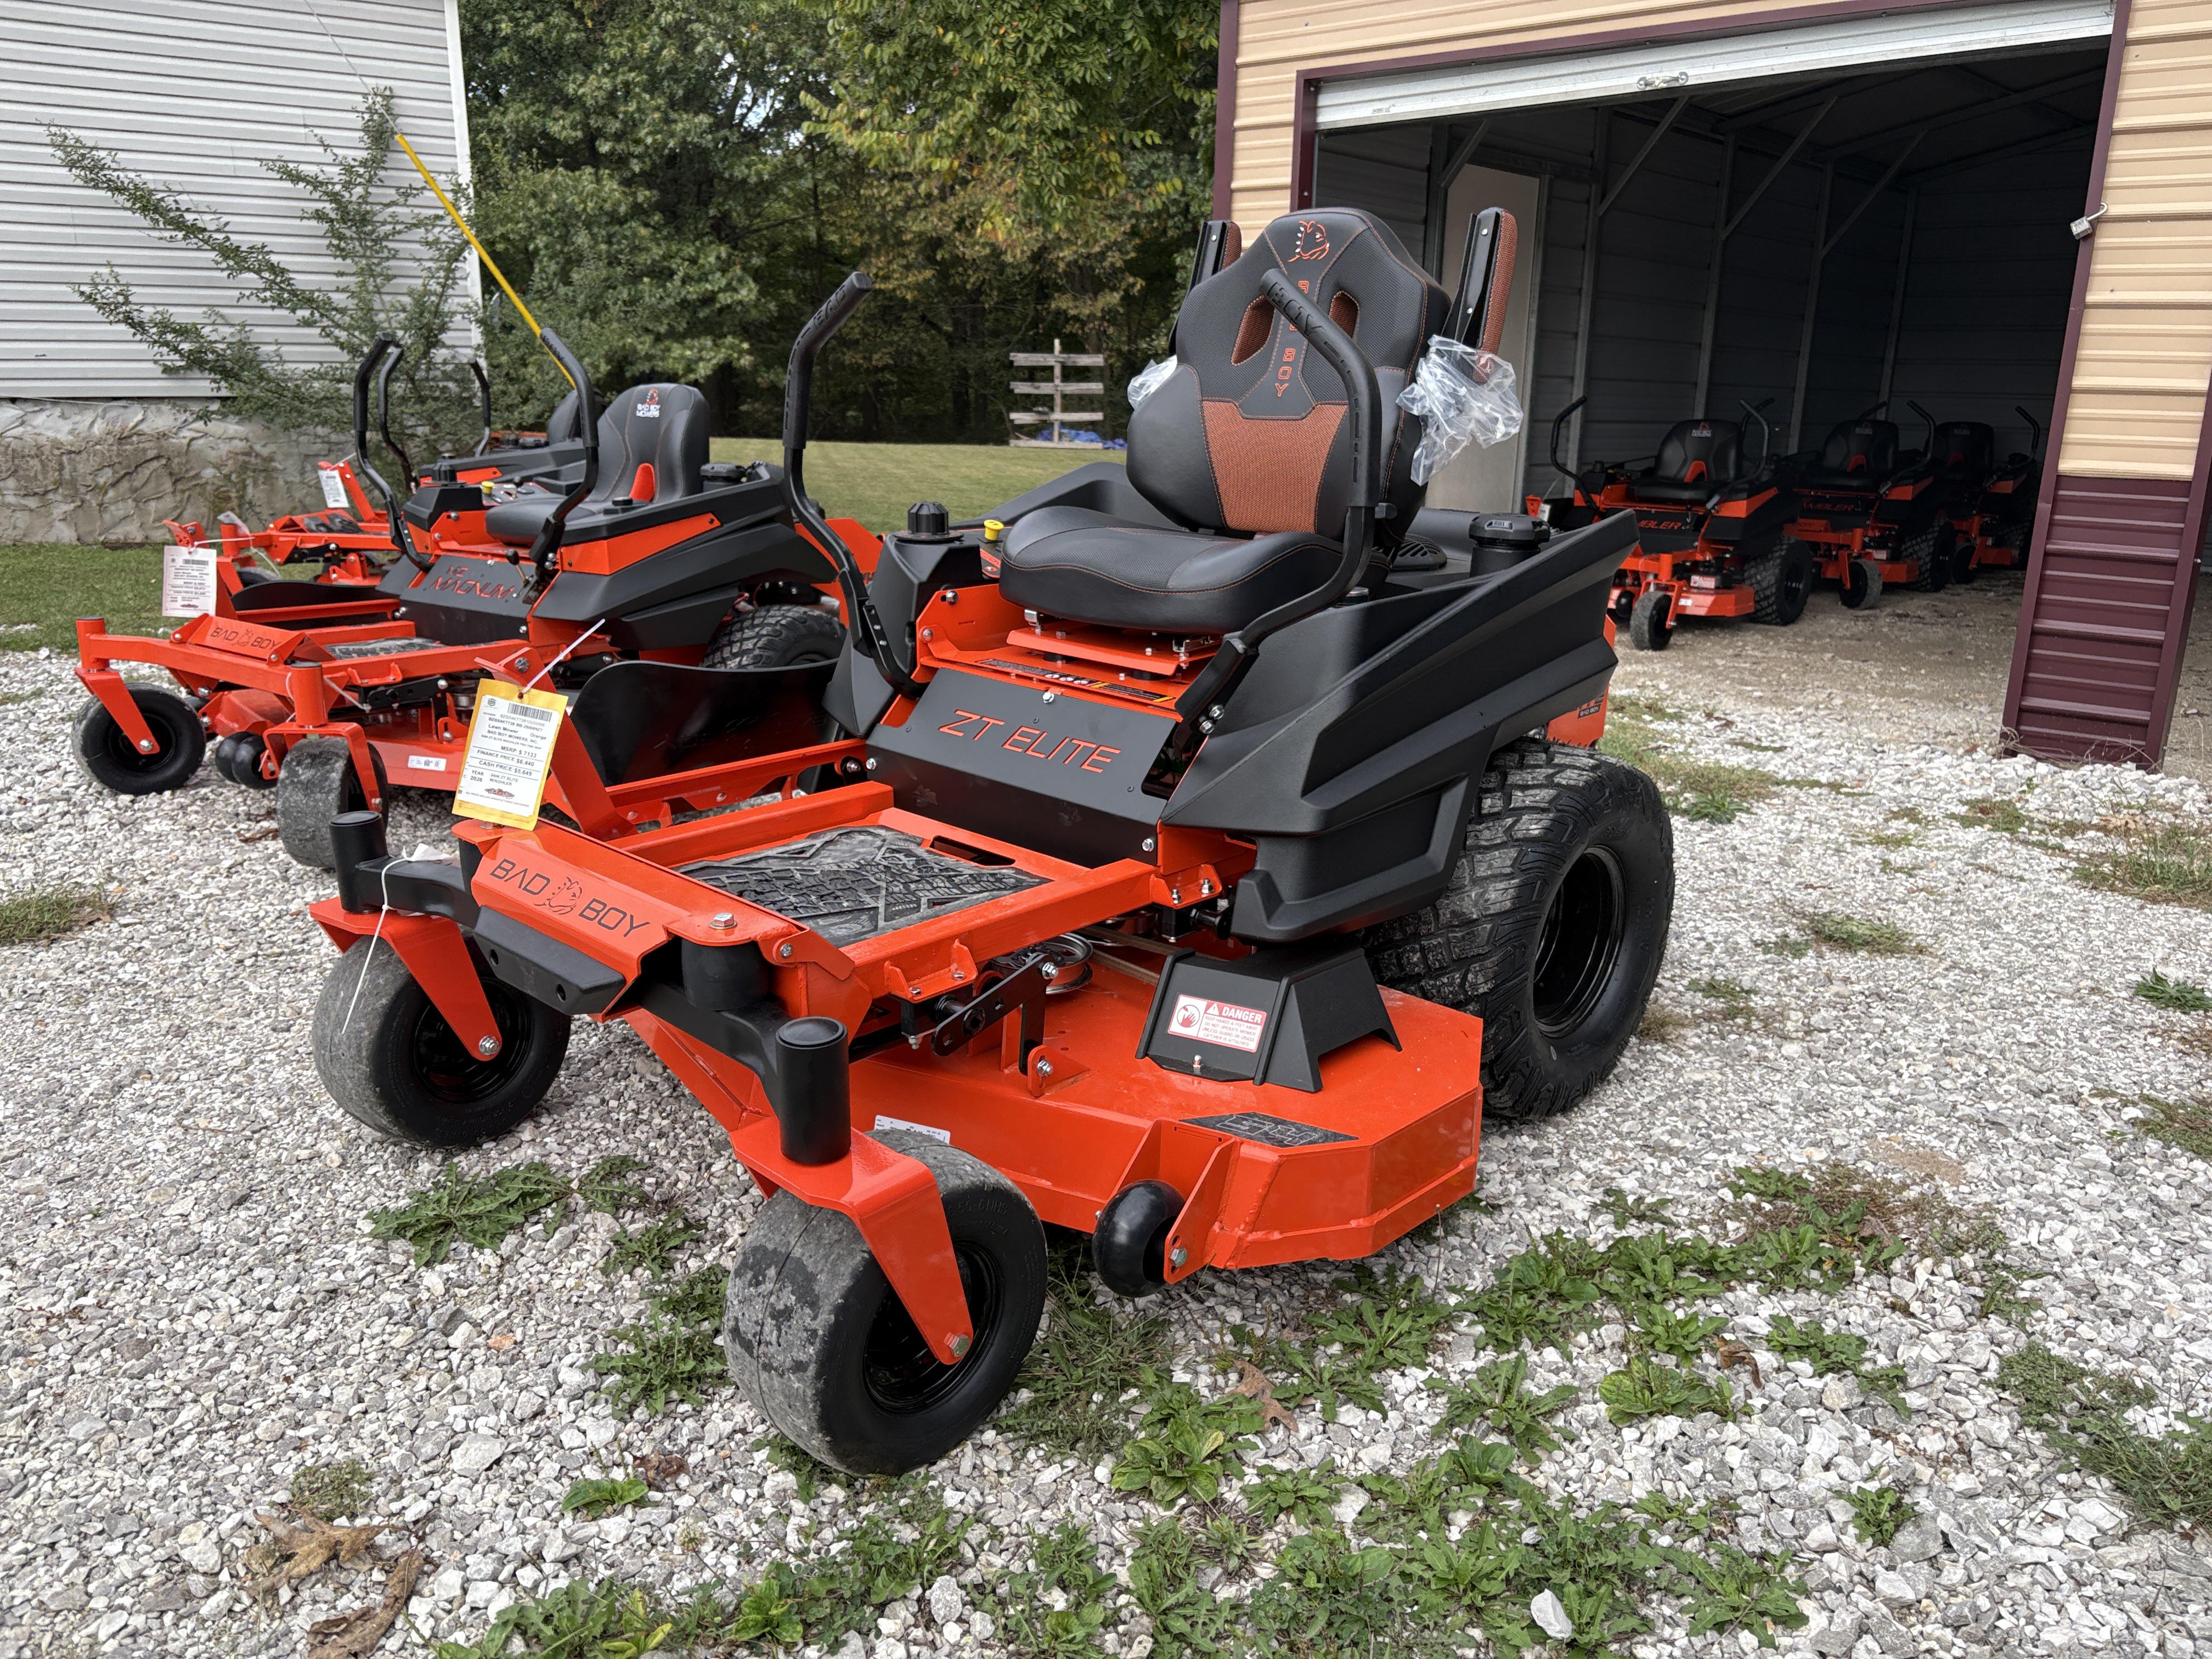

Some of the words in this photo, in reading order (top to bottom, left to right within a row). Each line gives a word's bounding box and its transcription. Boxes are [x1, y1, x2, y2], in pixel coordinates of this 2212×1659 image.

[1275, 348, 1296, 398] BOY
[430, 577, 515, 600] MAGNUM
[210, 628, 239, 641] BAD
[251, 636, 281, 650] BOY
[938, 709, 1006, 741] ZT
[1001, 725, 1121, 774] ELITE
[490, 858, 551, 895] BAD
[578, 898, 651, 938] BOY
[1222, 1007, 1262, 1024] DANGER
[1221, 1025, 1238, 1033] OPERATE
[1228, 1038, 1249, 1047] ATTACHED
